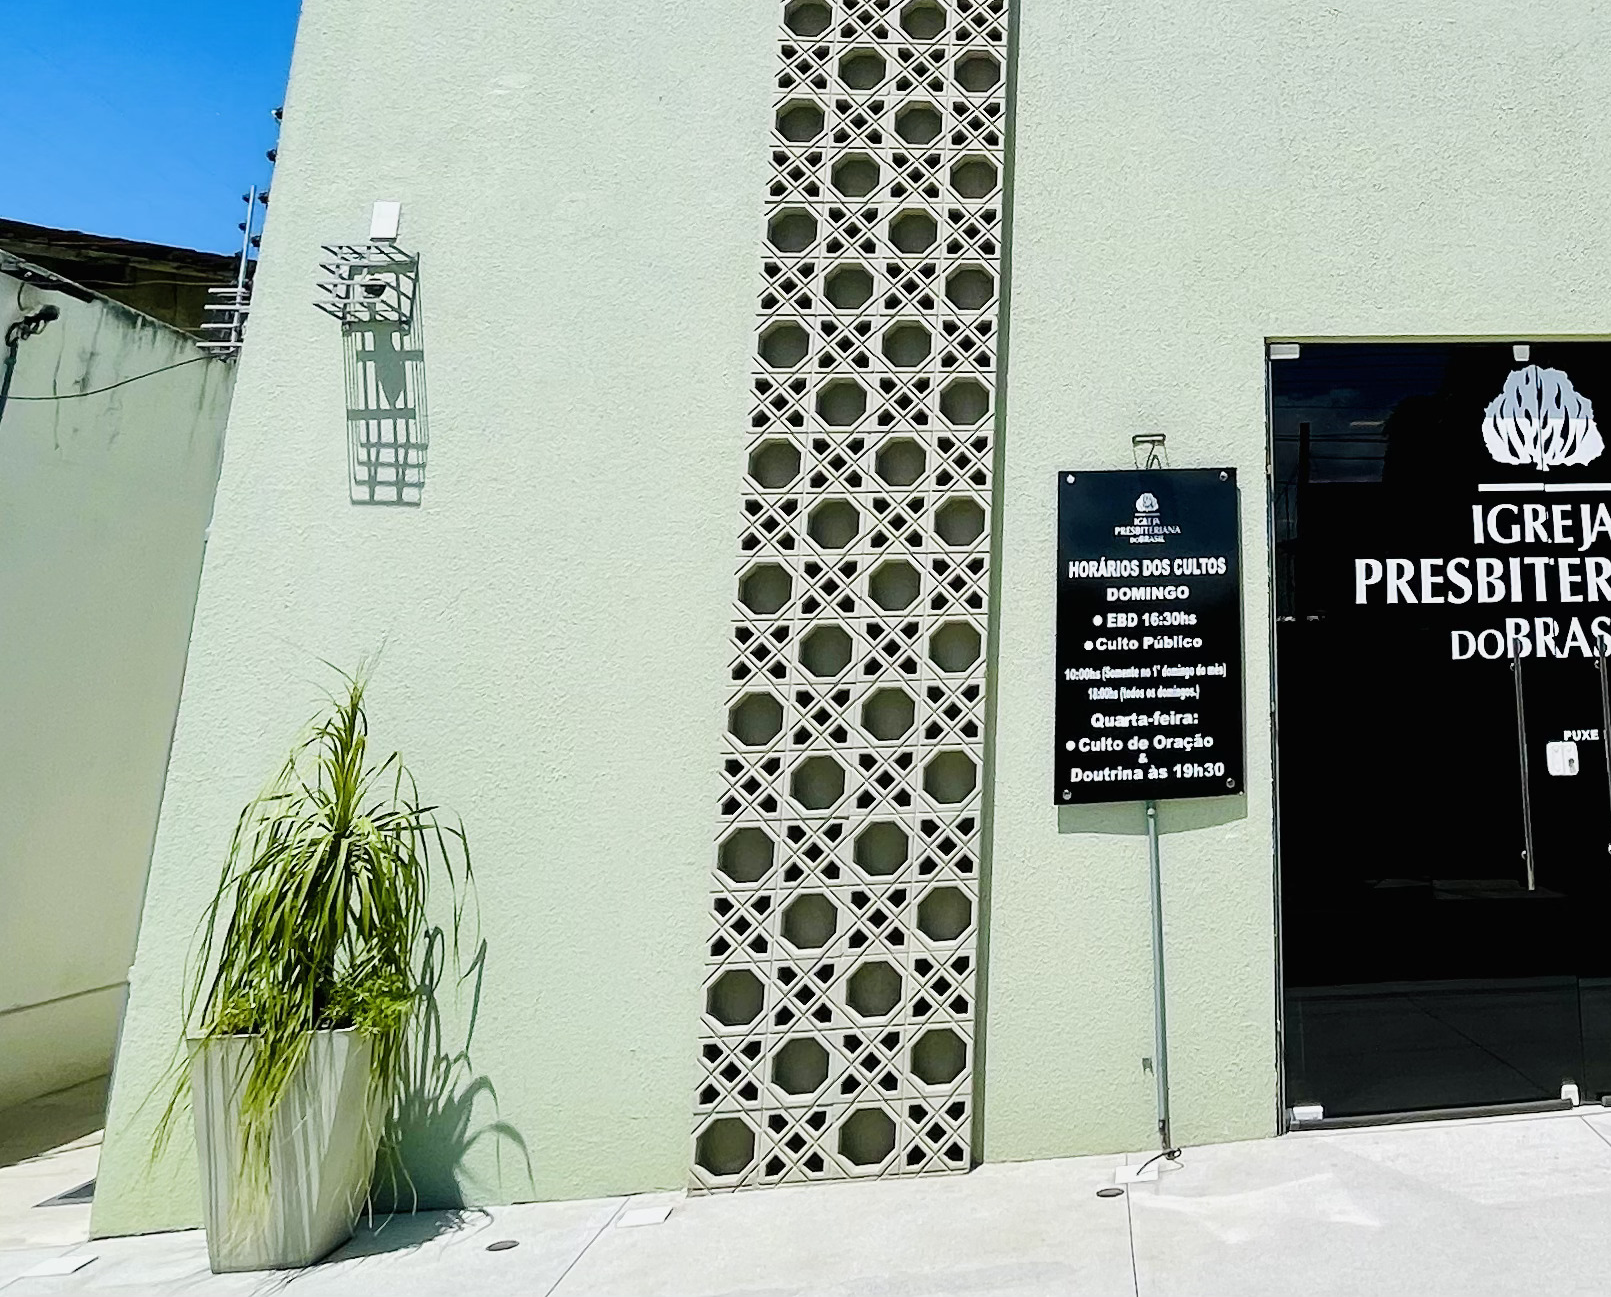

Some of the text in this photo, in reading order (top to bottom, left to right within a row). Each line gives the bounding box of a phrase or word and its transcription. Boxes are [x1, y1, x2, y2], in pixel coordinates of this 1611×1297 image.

[1068, 556, 1227, 578] HORÁRIOS DOS CULTOS
[1106, 585, 1190, 602] DOMINGO
[1106, 611, 1198, 628] EBD 16:30hs
[1095, 635, 1203, 651] Culto Público
[1064, 667, 1101, 681] 10:00hs
[1090, 711, 1199, 728] Quarta-feira:
[1078, 733, 1214, 752] Culto de Oração
[1563, 729, 1600, 741] PUXE
[1137, 753, 1149, 764] &
[1070, 762, 1225, 783] Doutrina às 19h30
